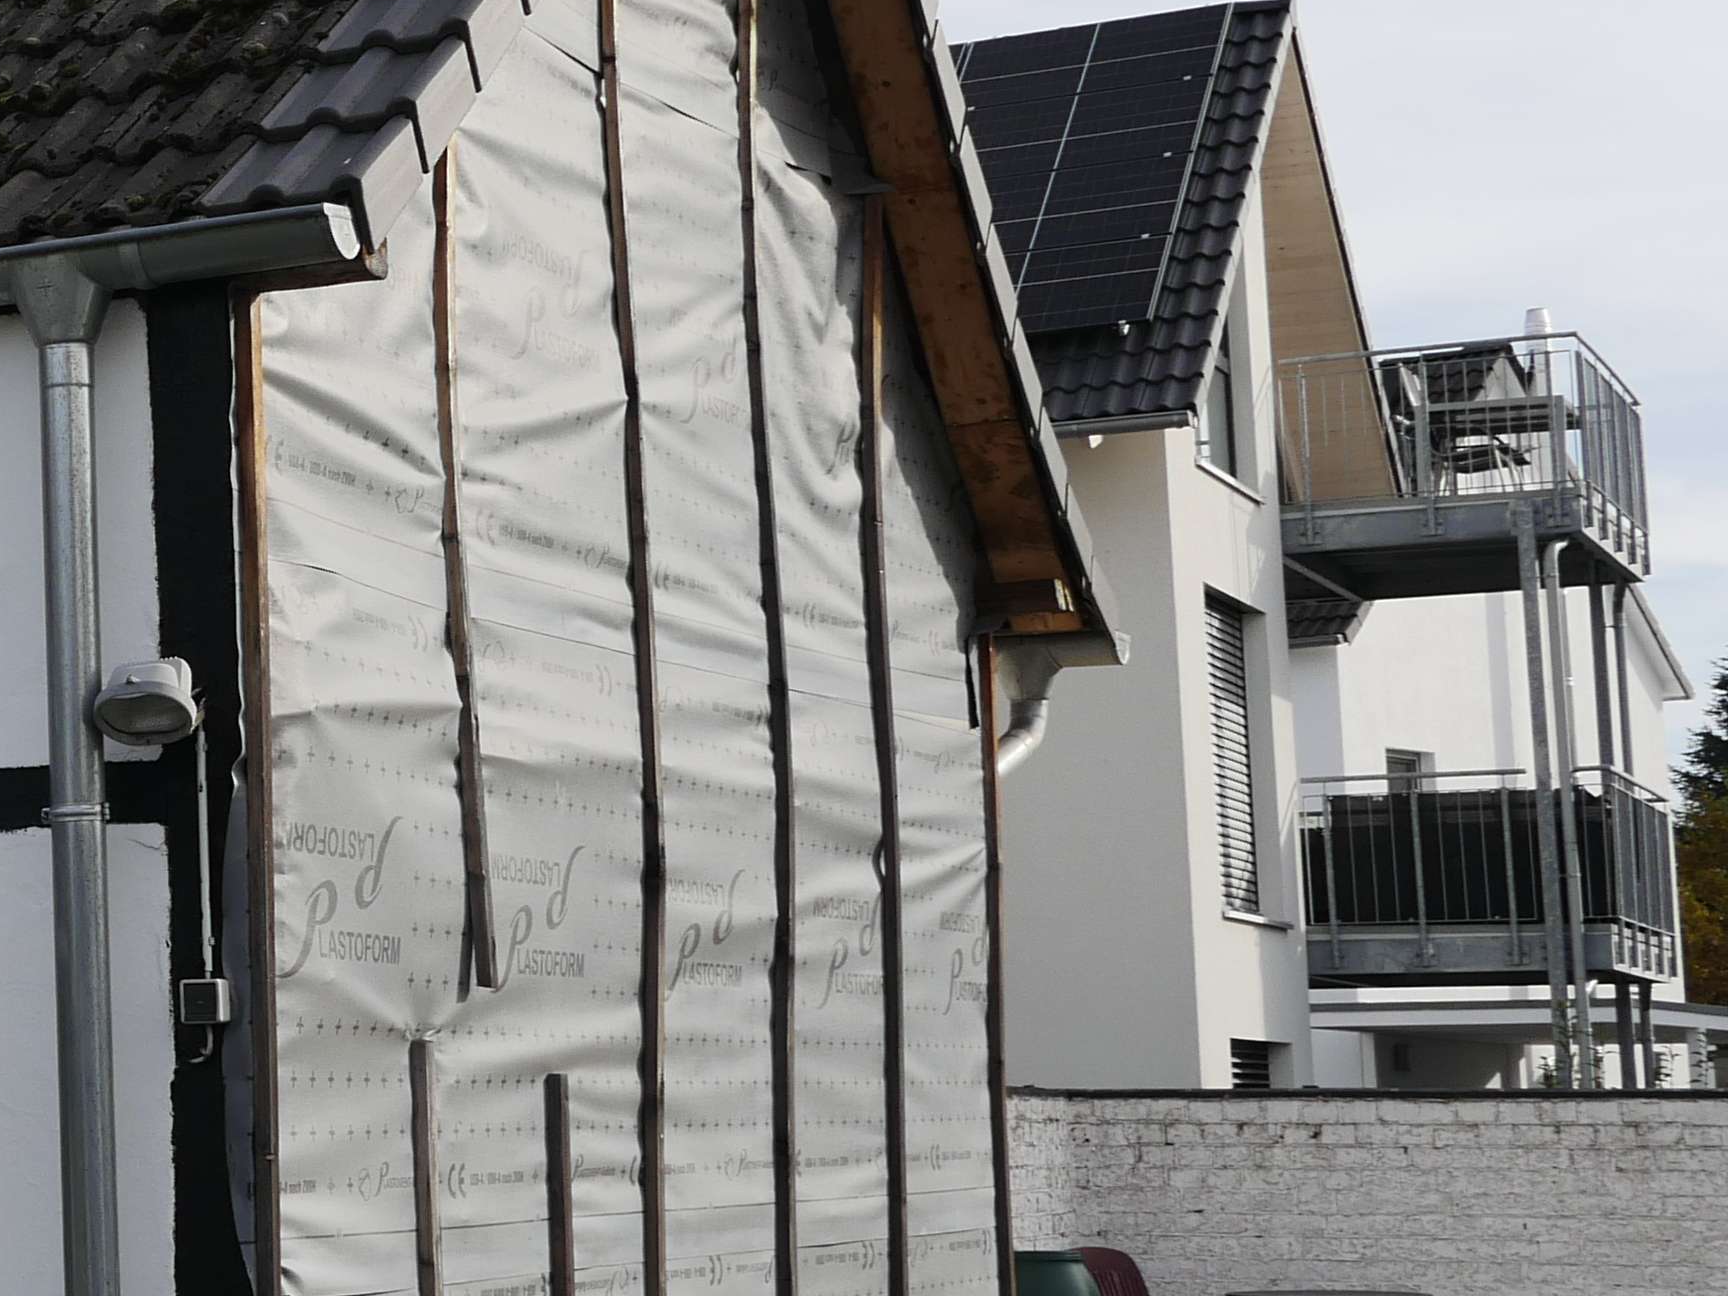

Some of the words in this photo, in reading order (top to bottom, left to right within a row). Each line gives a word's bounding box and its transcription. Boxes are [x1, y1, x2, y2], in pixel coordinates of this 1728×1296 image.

[276, 879, 402, 979] PLASTOFORM
[494, 904, 585, 994] PLASTOFORM
[665, 923, 743, 1003] PLASTOFORM
